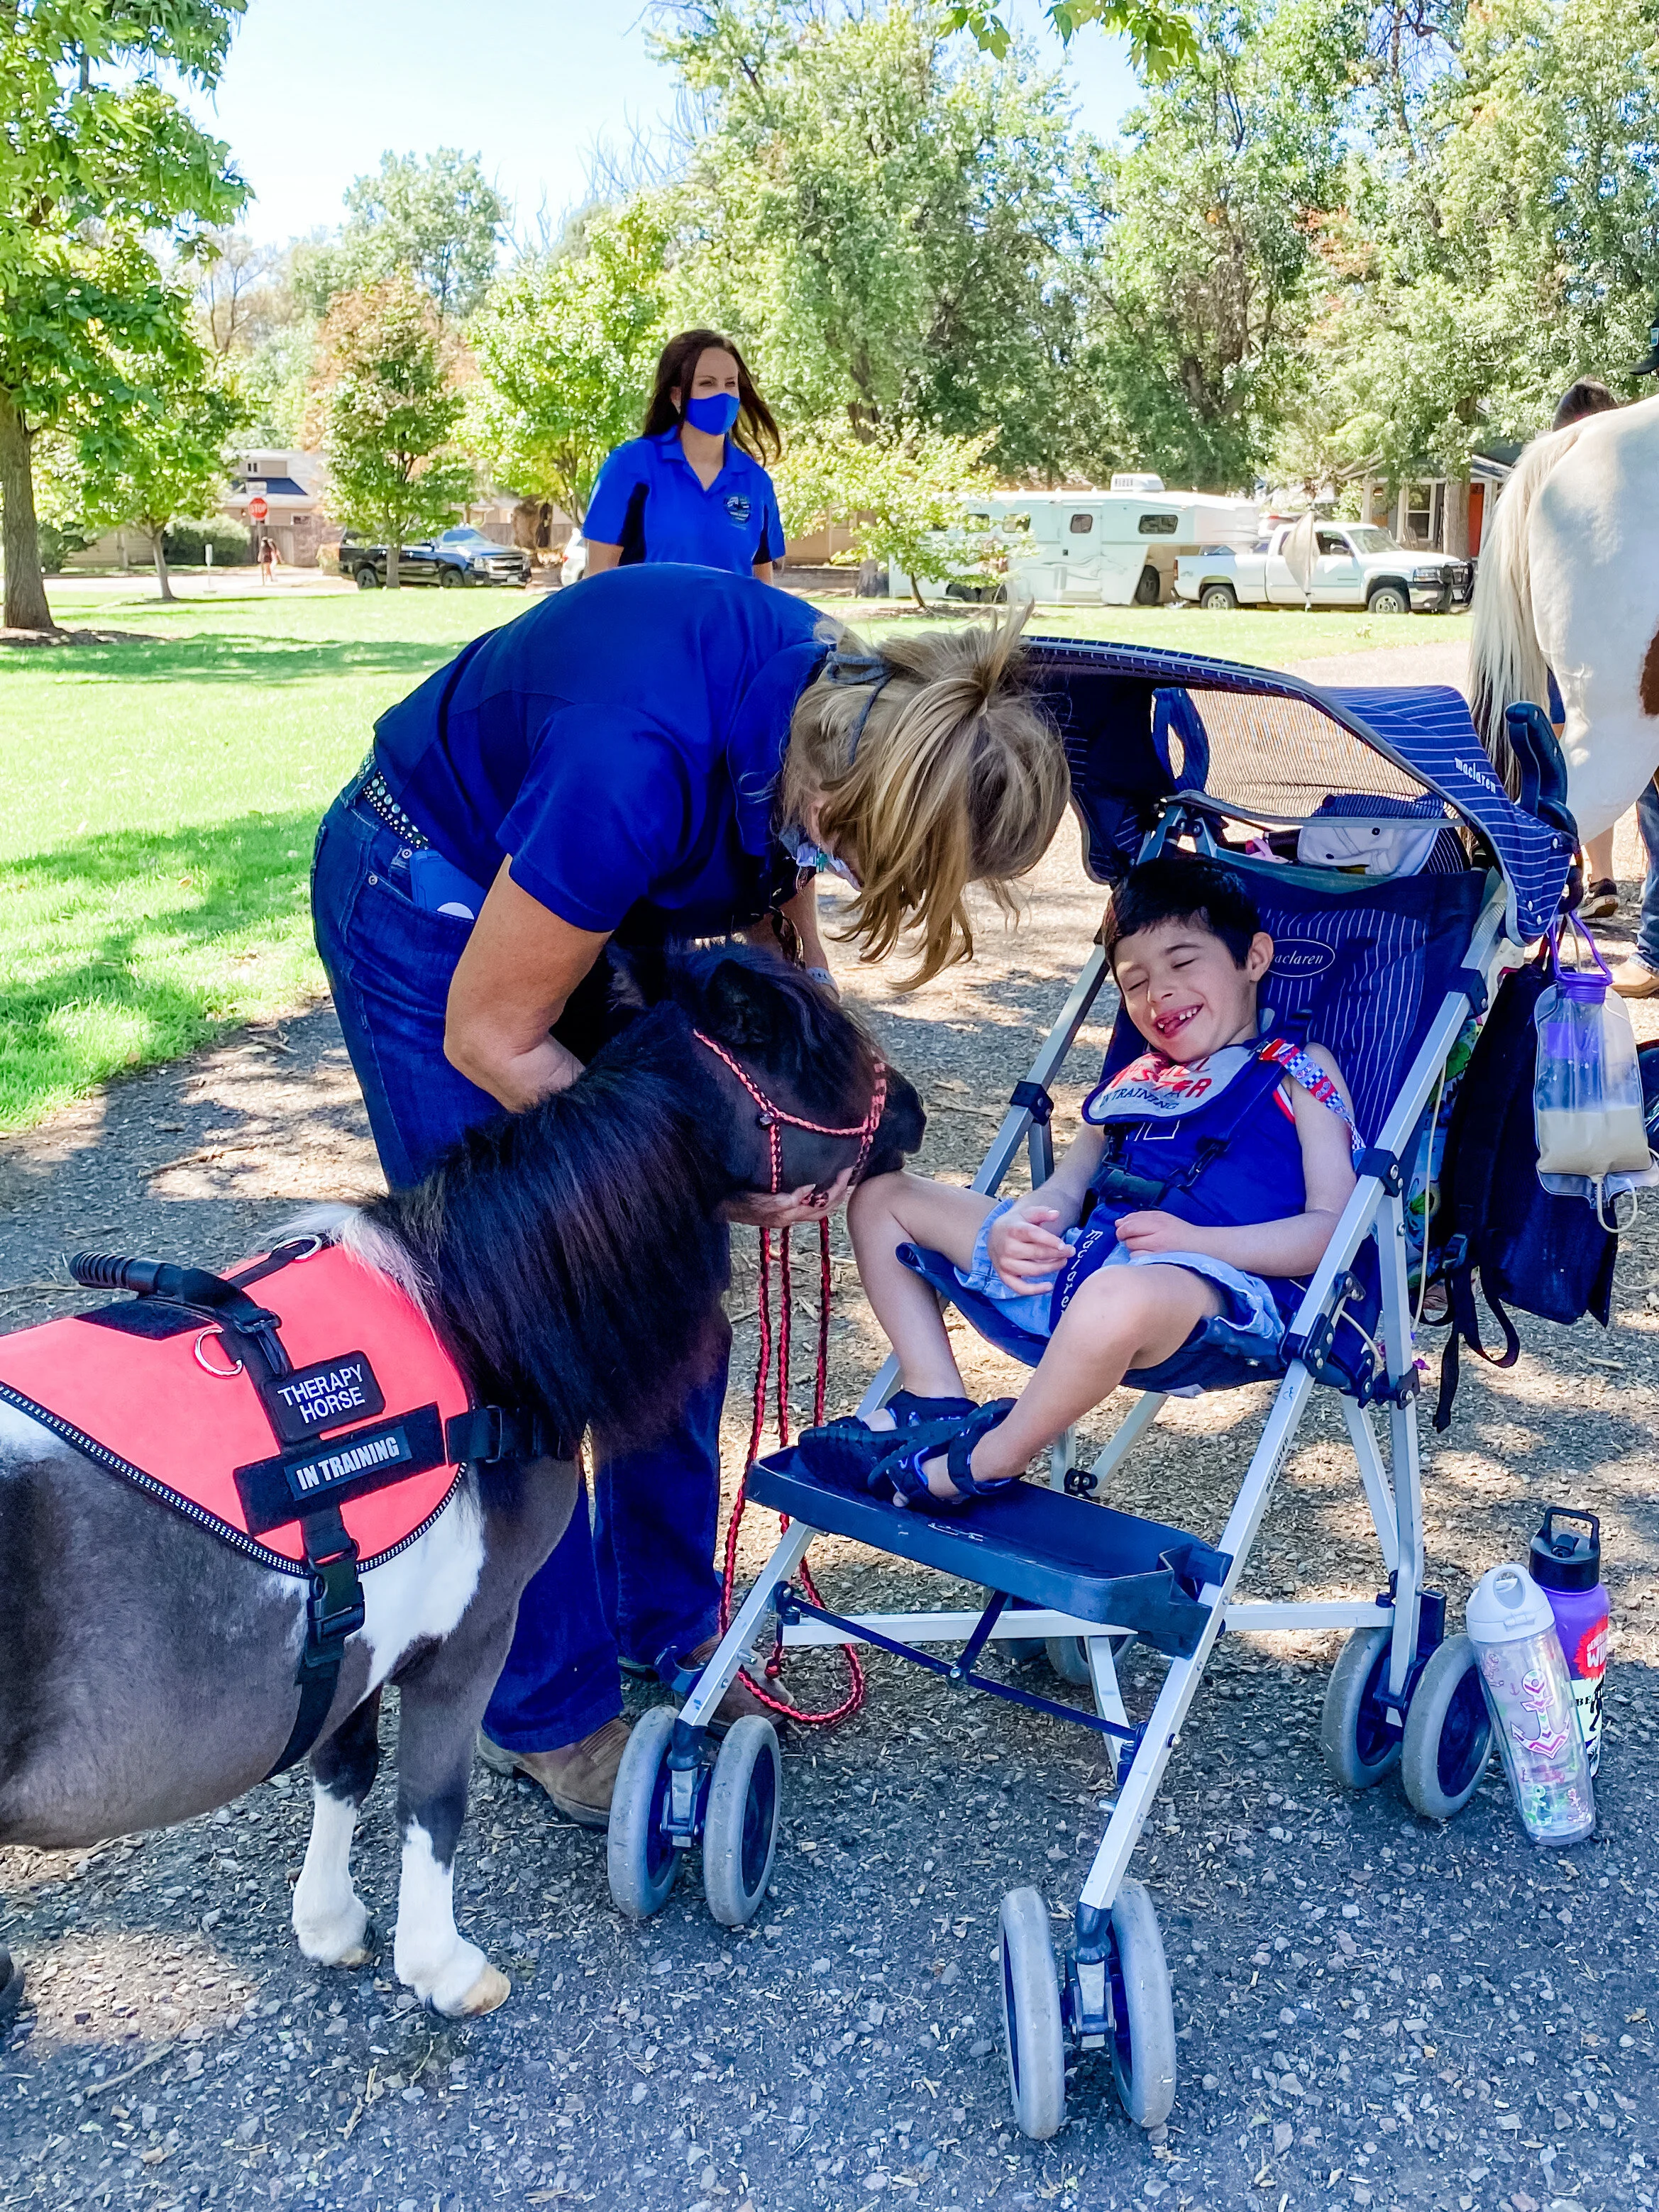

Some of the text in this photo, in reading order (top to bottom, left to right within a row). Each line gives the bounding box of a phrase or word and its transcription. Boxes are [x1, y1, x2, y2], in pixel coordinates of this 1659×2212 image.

[249, 503, 267, 514] STOP
[1454, 756, 1497, 794] maclaren
[1273, 950, 1323, 965] aclaren
[1111, 1088, 1179, 1110] TRAINING
[1060, 1229, 1103, 1313] maclare
[277, 1364, 363, 1407] THERAPY
[299, 1386, 365, 1424] HORSE
[296, 1437, 400, 1491] IN TRAINING
[1266, 1437, 1289, 1494] maclaren
